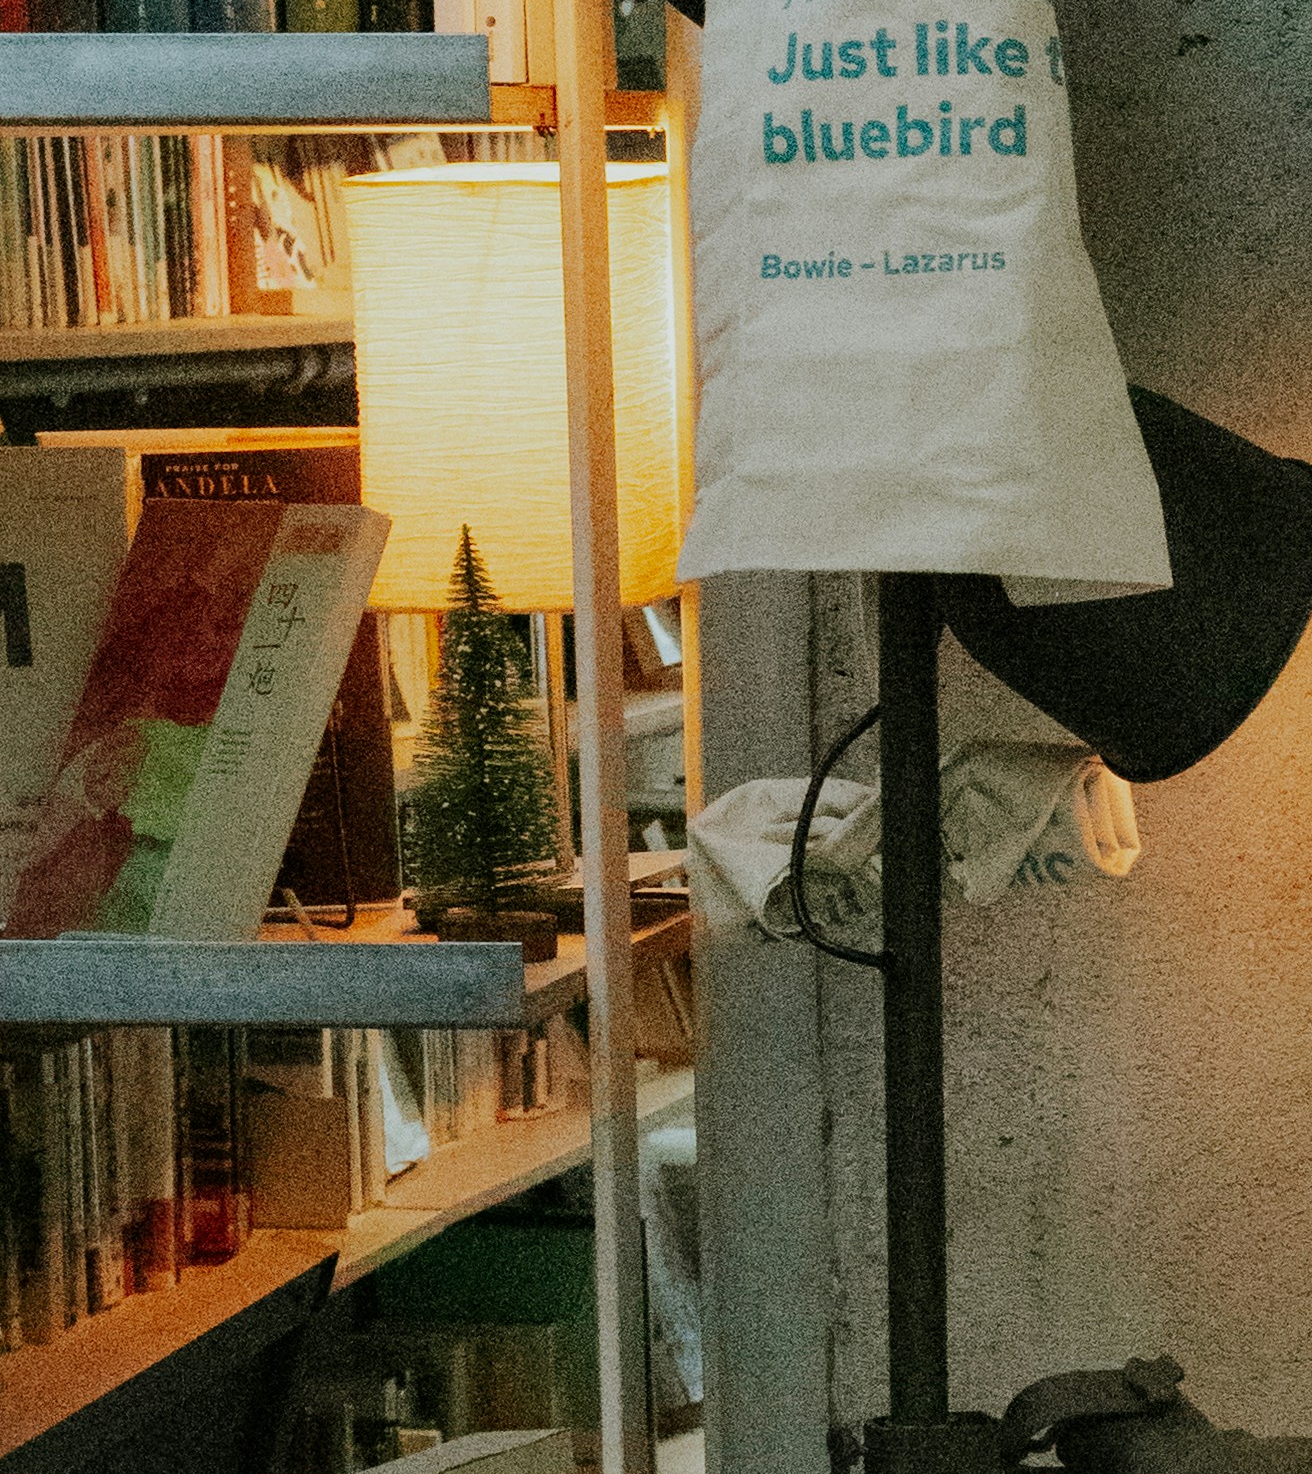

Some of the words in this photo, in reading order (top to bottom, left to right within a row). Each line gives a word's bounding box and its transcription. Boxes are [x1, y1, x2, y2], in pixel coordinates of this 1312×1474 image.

[767, 28, 897, 86] Just
[916, 20, 1029, 79] like
[763, 102, 1027, 165] bluebird
[760, 255, 853, 281] Bowie
[884, 248, 1006, 277] Lazarus
[154, 475, 282, 498] ANDELA
